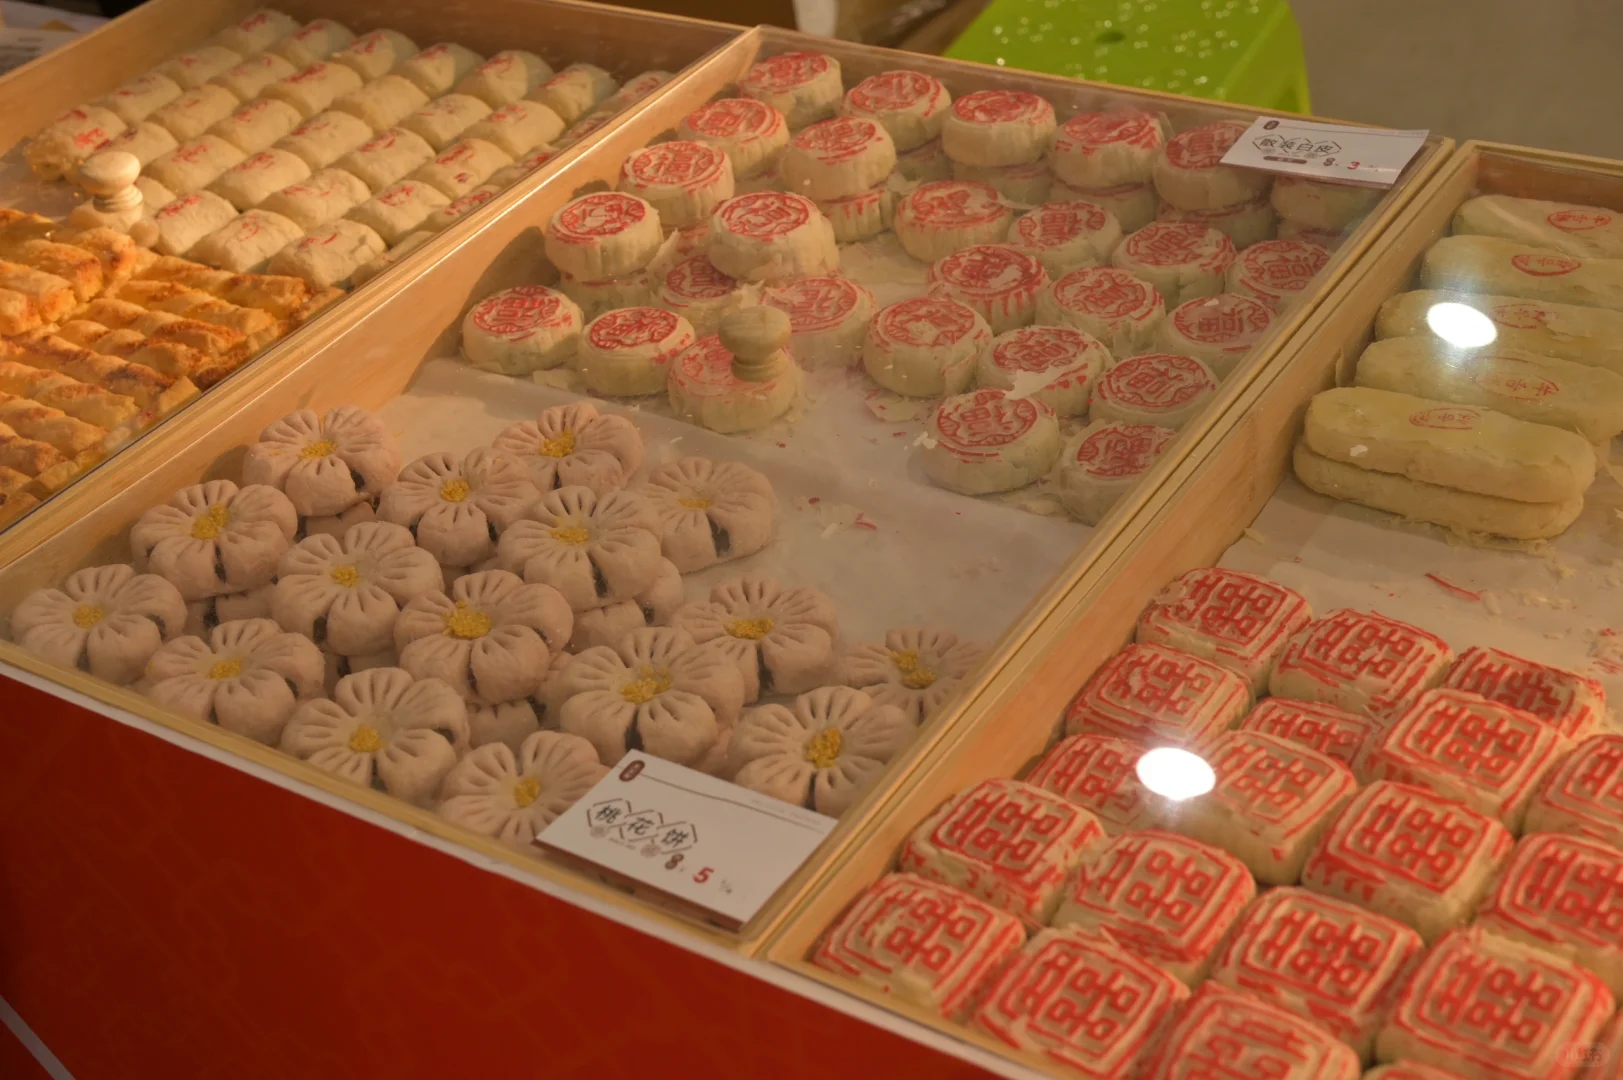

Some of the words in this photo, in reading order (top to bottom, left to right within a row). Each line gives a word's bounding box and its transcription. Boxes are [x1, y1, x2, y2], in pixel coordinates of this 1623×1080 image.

[594, 804, 689, 848] 桃花饼
[692, 866, 715, 884] 5
